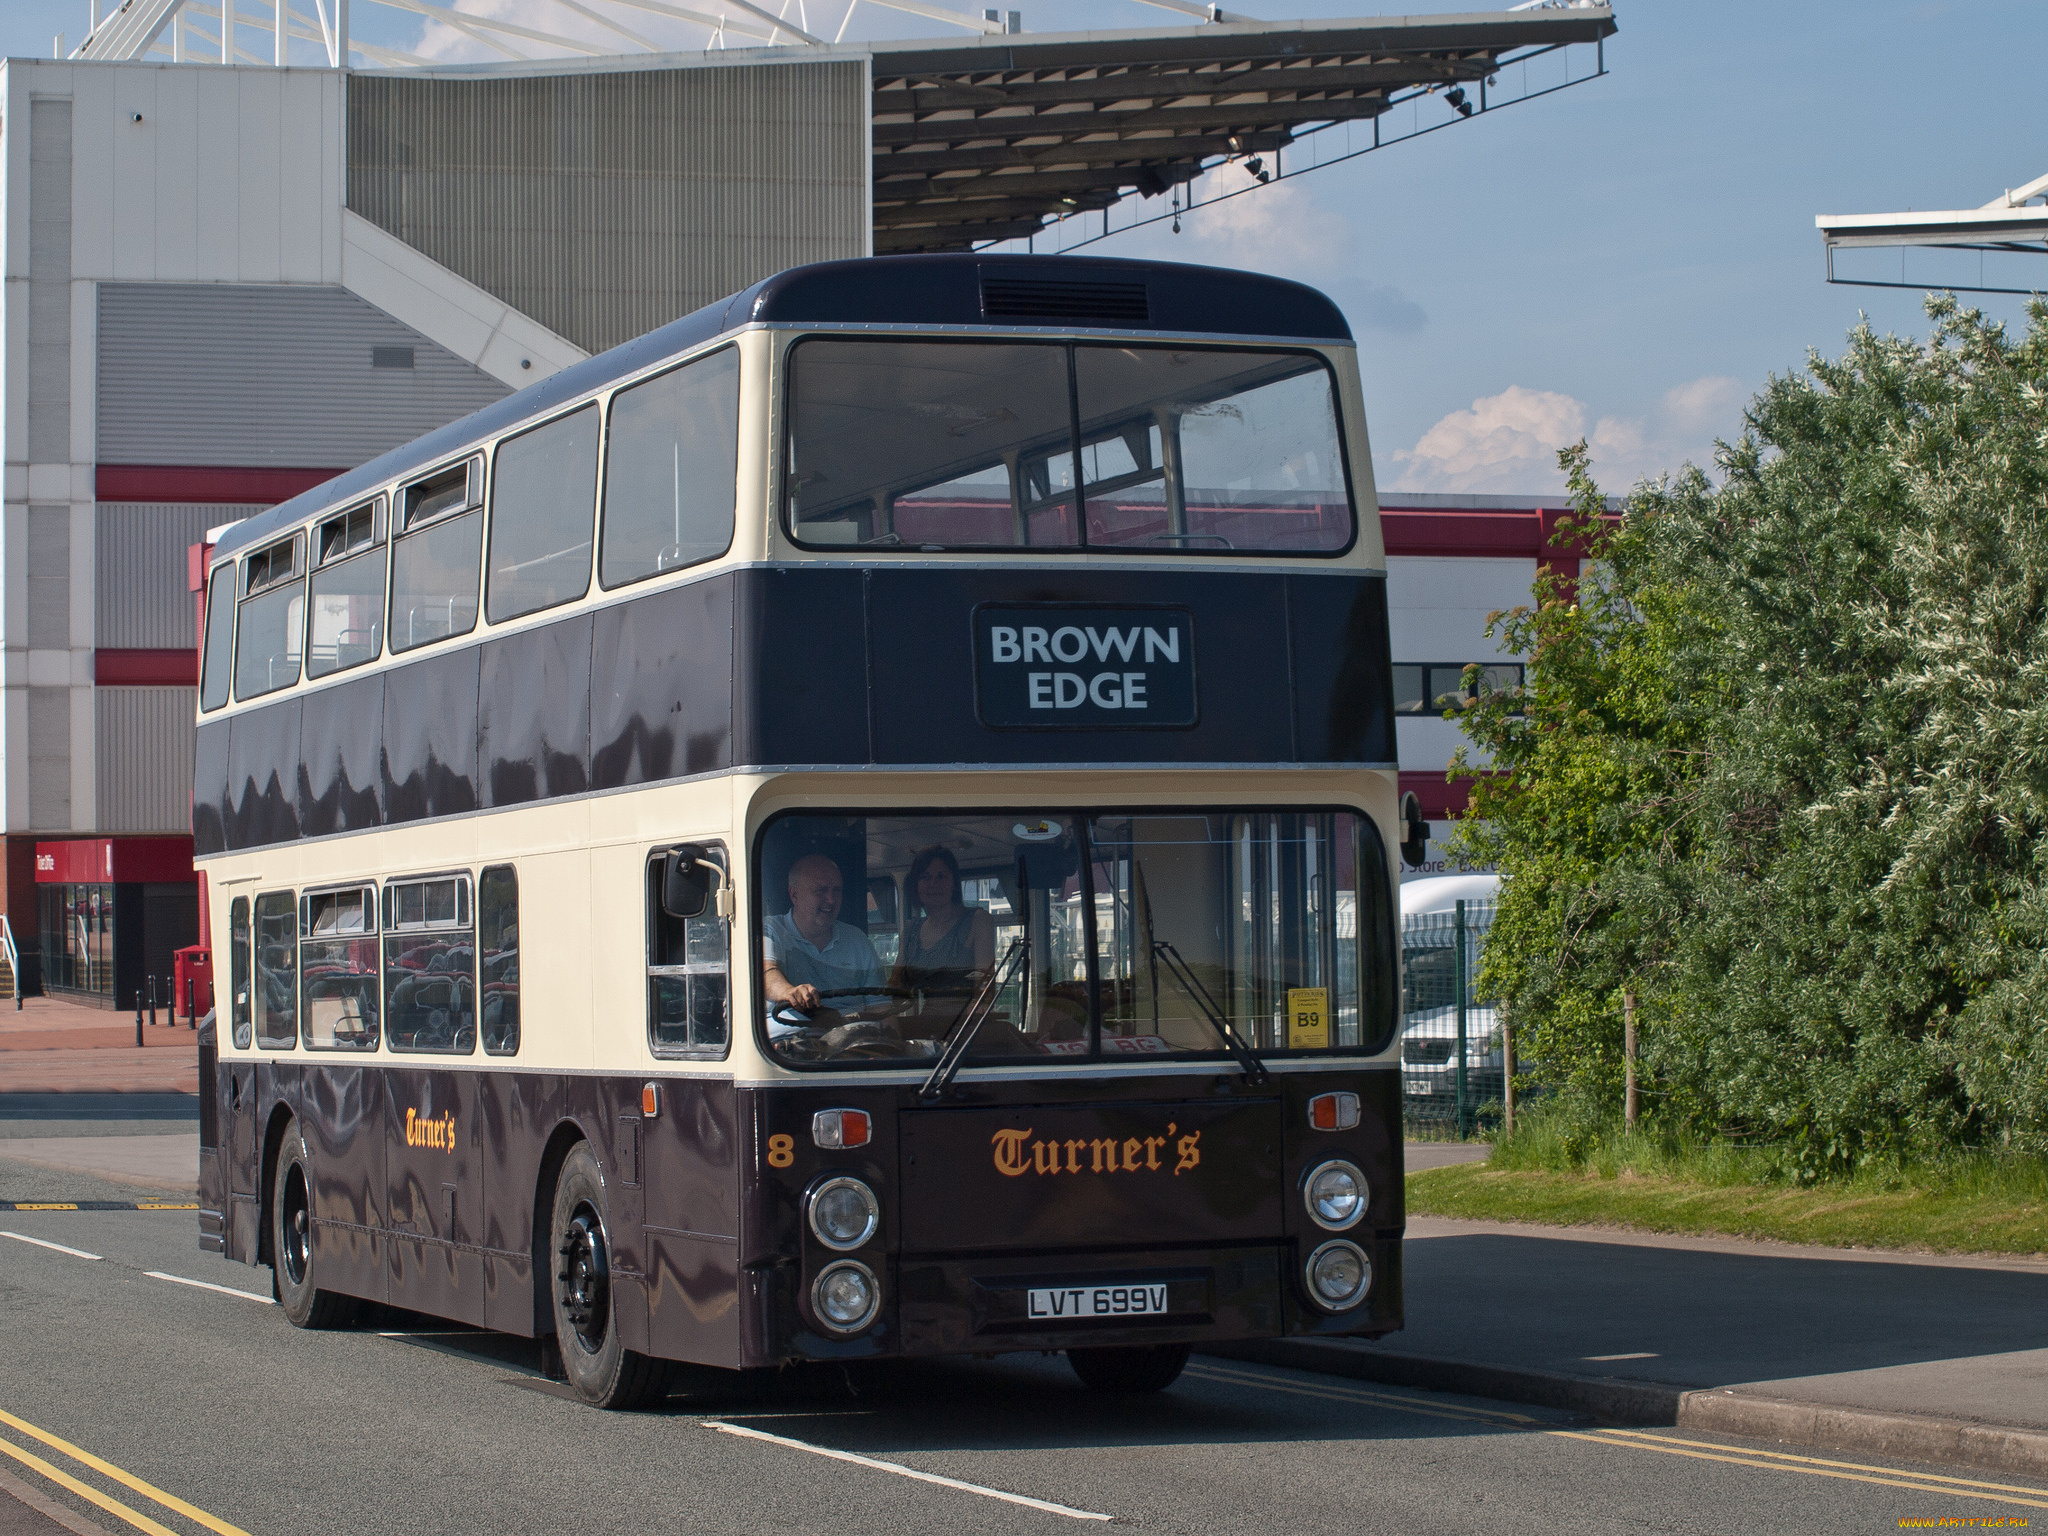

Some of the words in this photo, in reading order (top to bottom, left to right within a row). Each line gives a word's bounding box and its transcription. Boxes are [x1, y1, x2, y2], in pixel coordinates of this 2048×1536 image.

[991, 626, 1180, 663] BROWN
[1028, 672, 1148, 709] EDGE
[1297, 1012, 1319, 1027] B9
[406, 1106, 455, 1155] Turner's
[991, 1121, 1201, 1176] Turner's
[768, 1133, 794, 1168] 8
[1030, 1290, 1085, 1316] LVT
[1093, 1287, 1165, 1314] 699V
